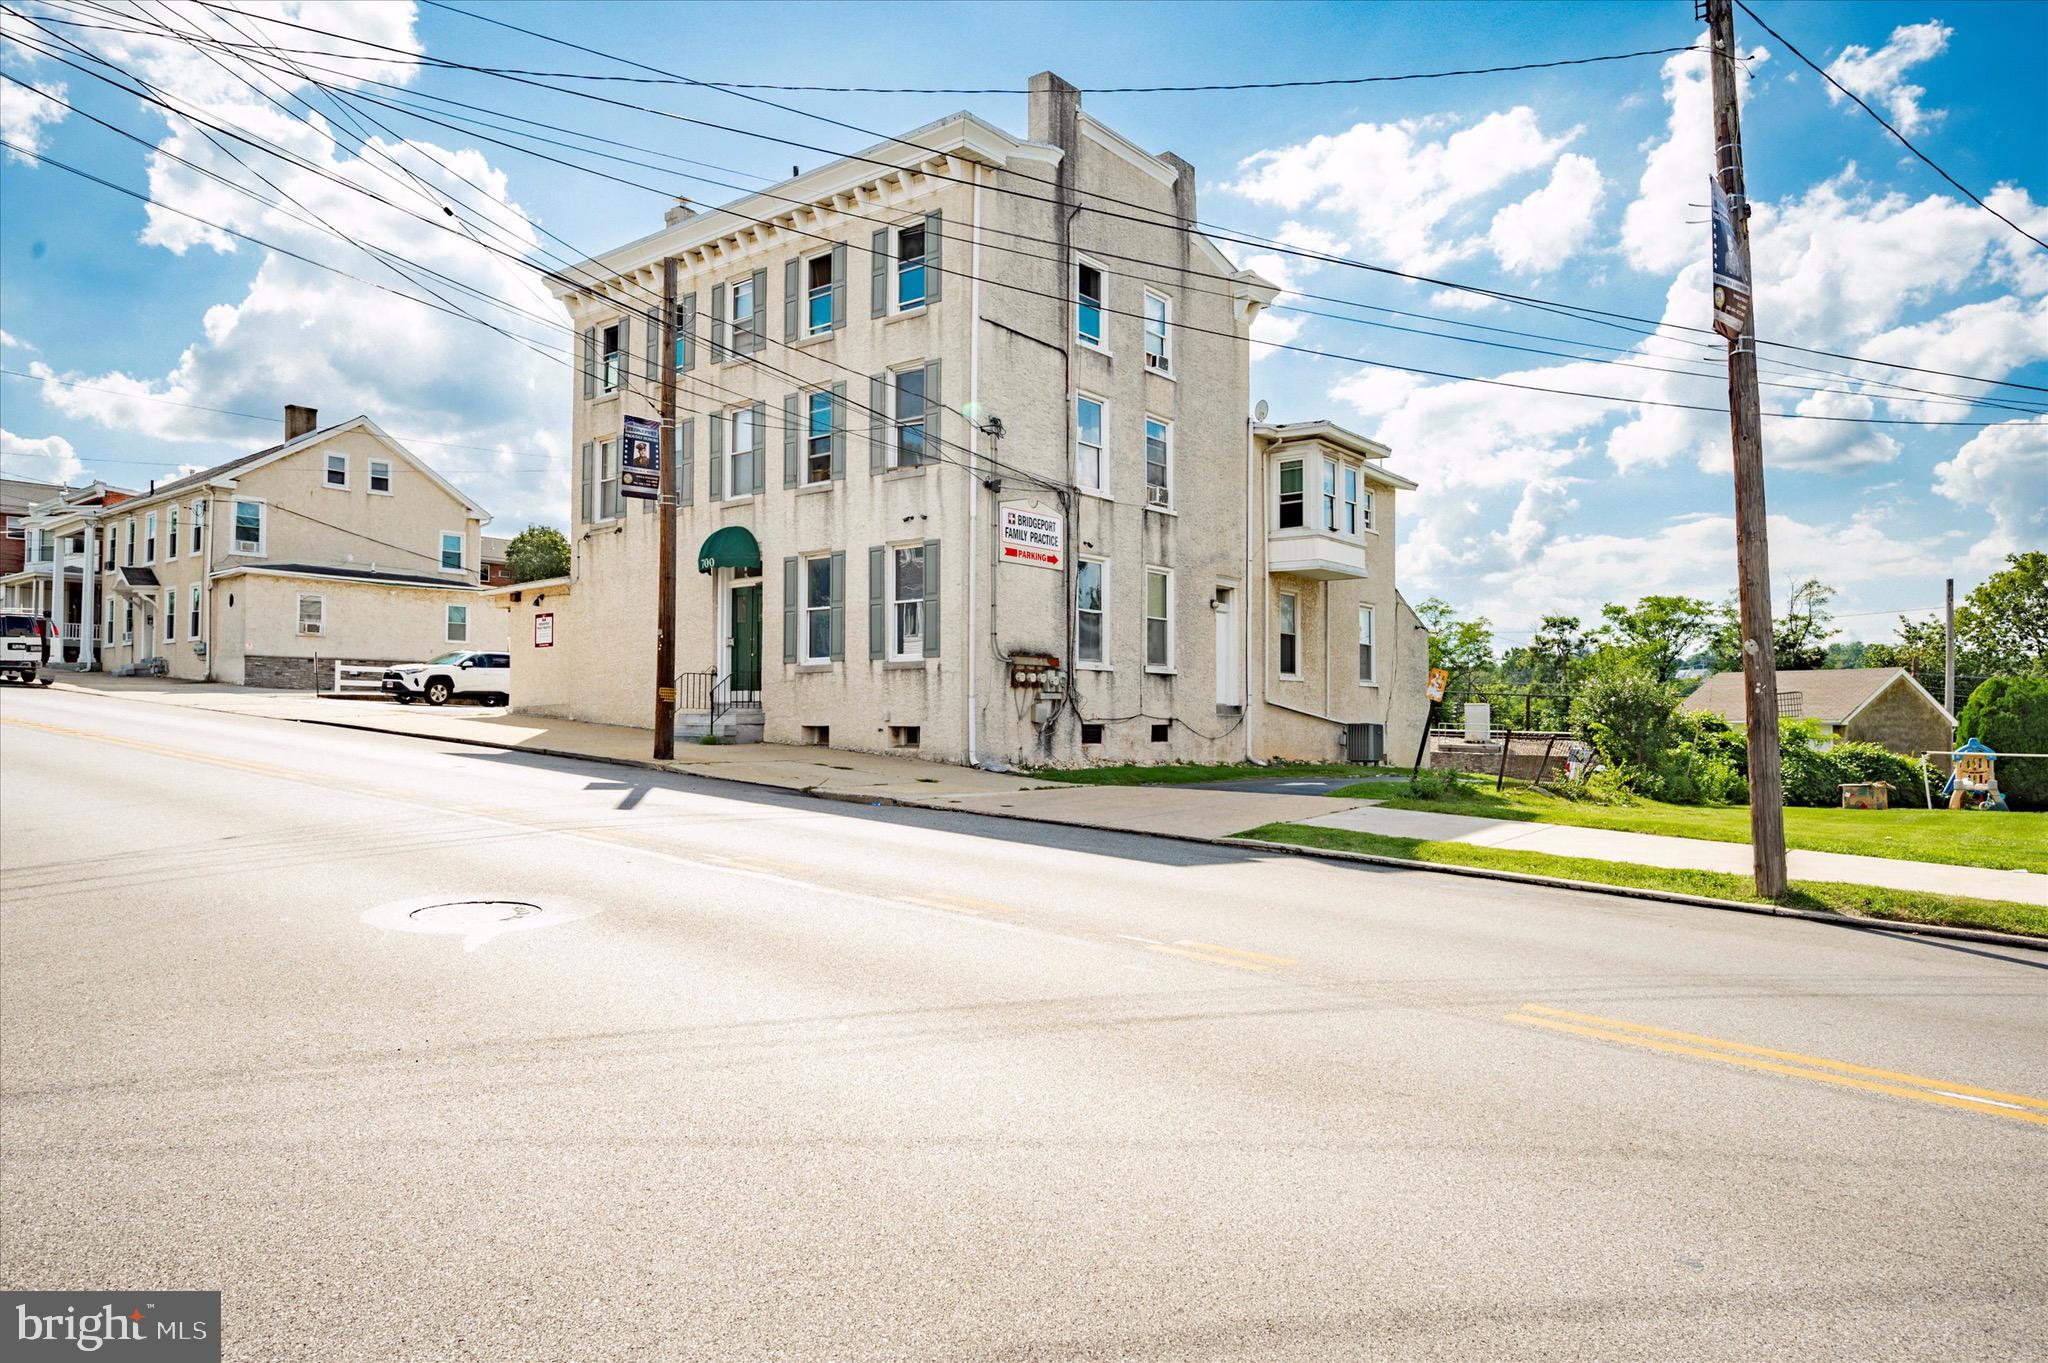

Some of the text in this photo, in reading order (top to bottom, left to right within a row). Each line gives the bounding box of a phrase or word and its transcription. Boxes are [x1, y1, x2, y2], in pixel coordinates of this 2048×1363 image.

[1017, 514, 1056, 532] BRIDGEPORT
[1005, 526, 1059, 547] FAMILY PRACTICE
[1018, 549, 1047, 561] PARKING
[701, 557, 715, 569] 700
